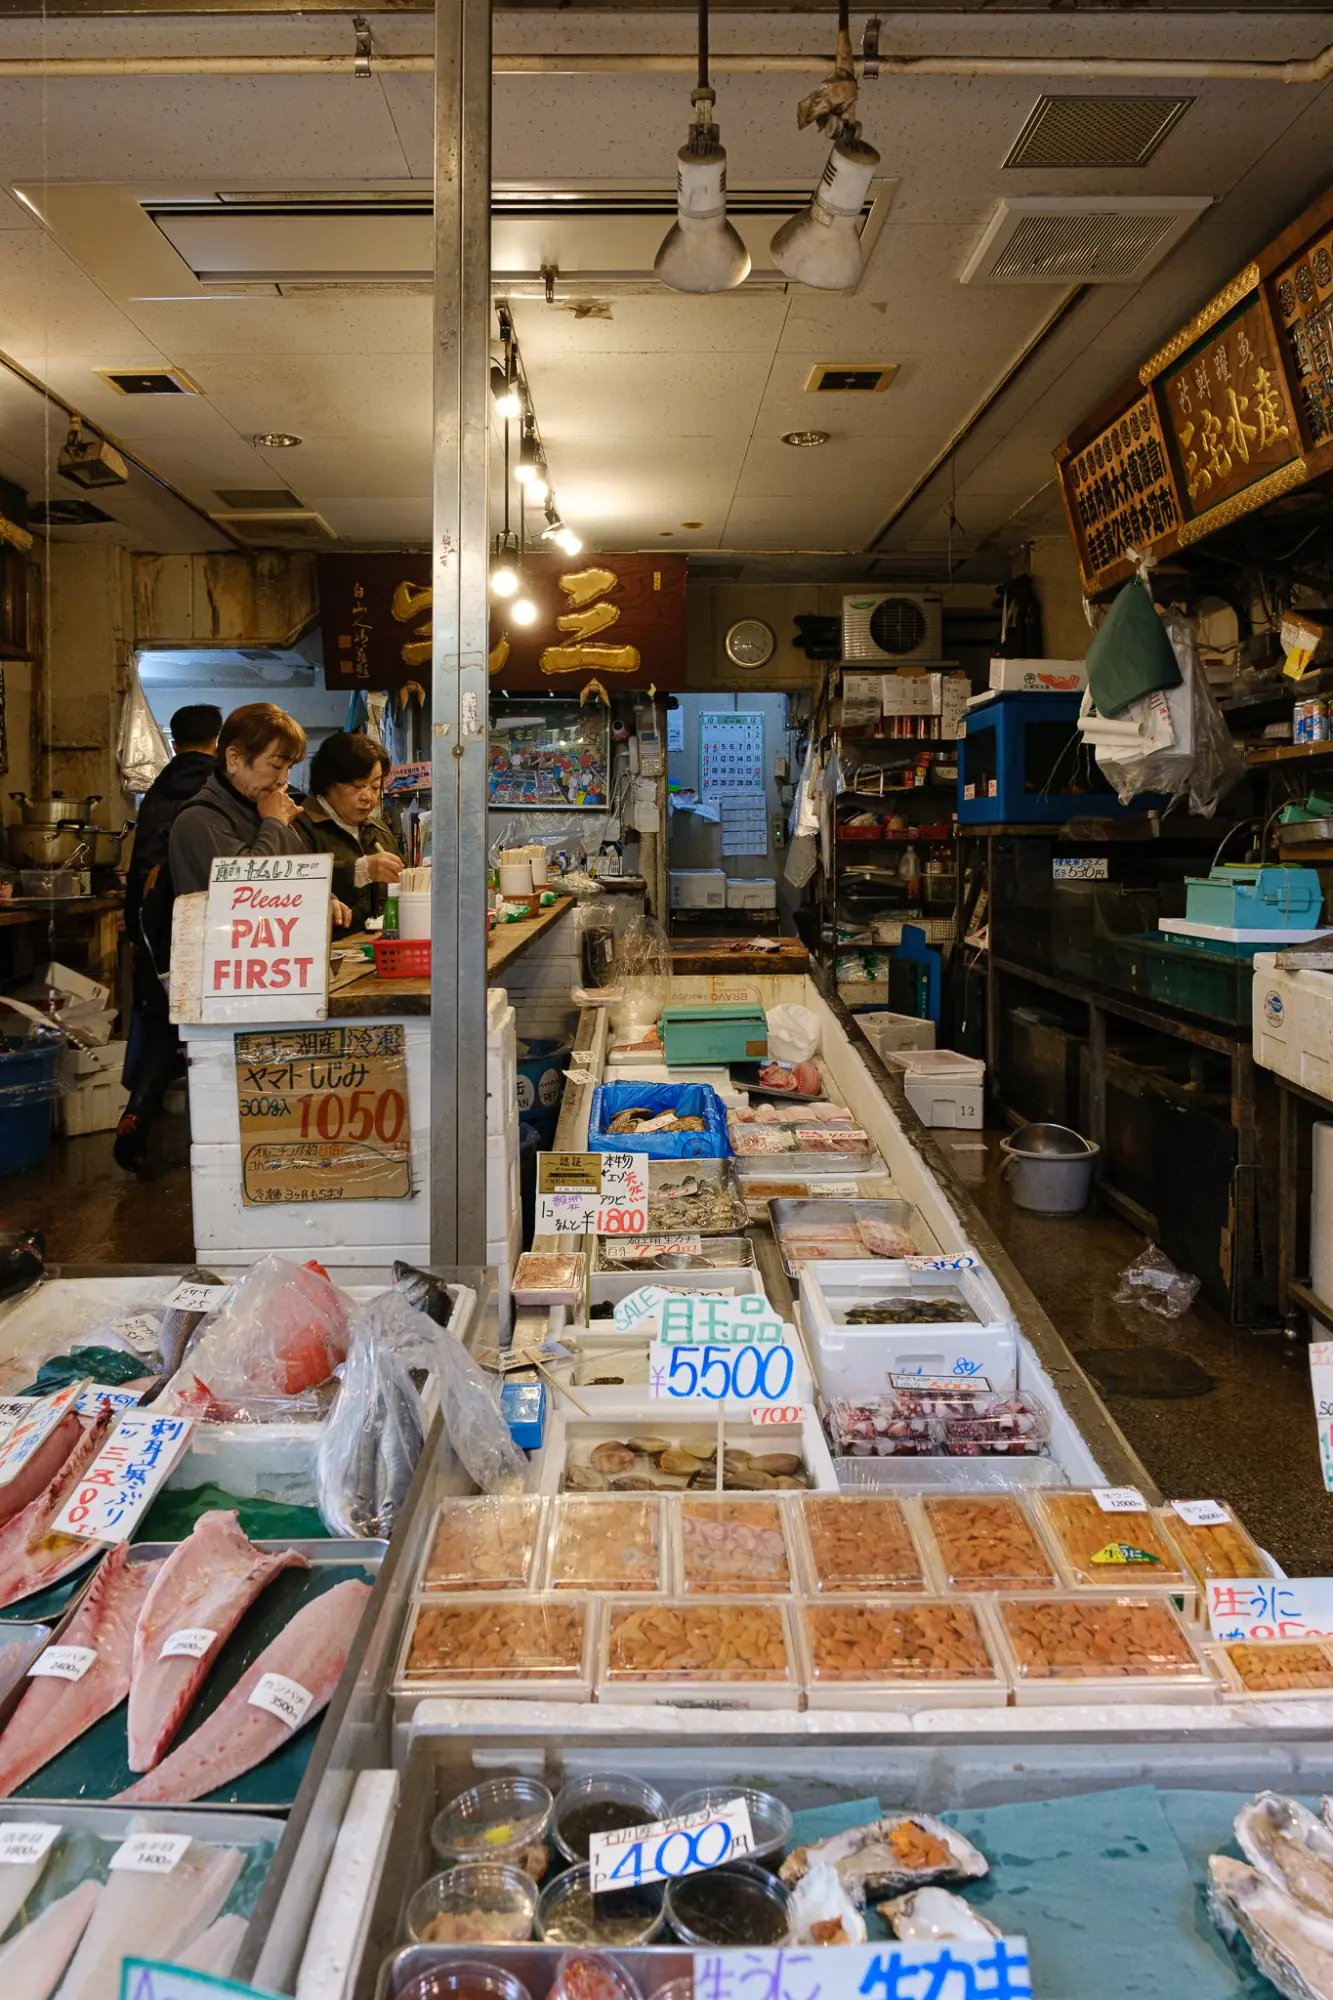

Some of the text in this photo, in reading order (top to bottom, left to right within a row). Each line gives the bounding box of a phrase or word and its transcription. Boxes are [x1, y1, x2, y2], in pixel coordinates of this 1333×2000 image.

[215, 858, 319, 881] 前払いで
[1068, 865, 1105, 878] 530円
[231, 885, 303, 911] Please
[231, 917, 300, 949] PAY
[213, 957, 314, 990] FIRST
[710, 992, 748, 1001] BRAVO
[353, 1027, 398, 1055] 冷凍
[297, 1089, 405, 1143] 1050
[960, 1105, 975, 1116] 12
[603, 1153, 634, 1169] 本物
[600, 1194, 627, 1206] アワビ
[555, 1218, 581, 1231] なんと
[614, 1285, 660, 1332] SALE
[661, 1296, 783, 1345] 目玉品
[1212, 1585, 1302, 1622] 生うに
[260, 1679, 306, 1706] カンパチ
